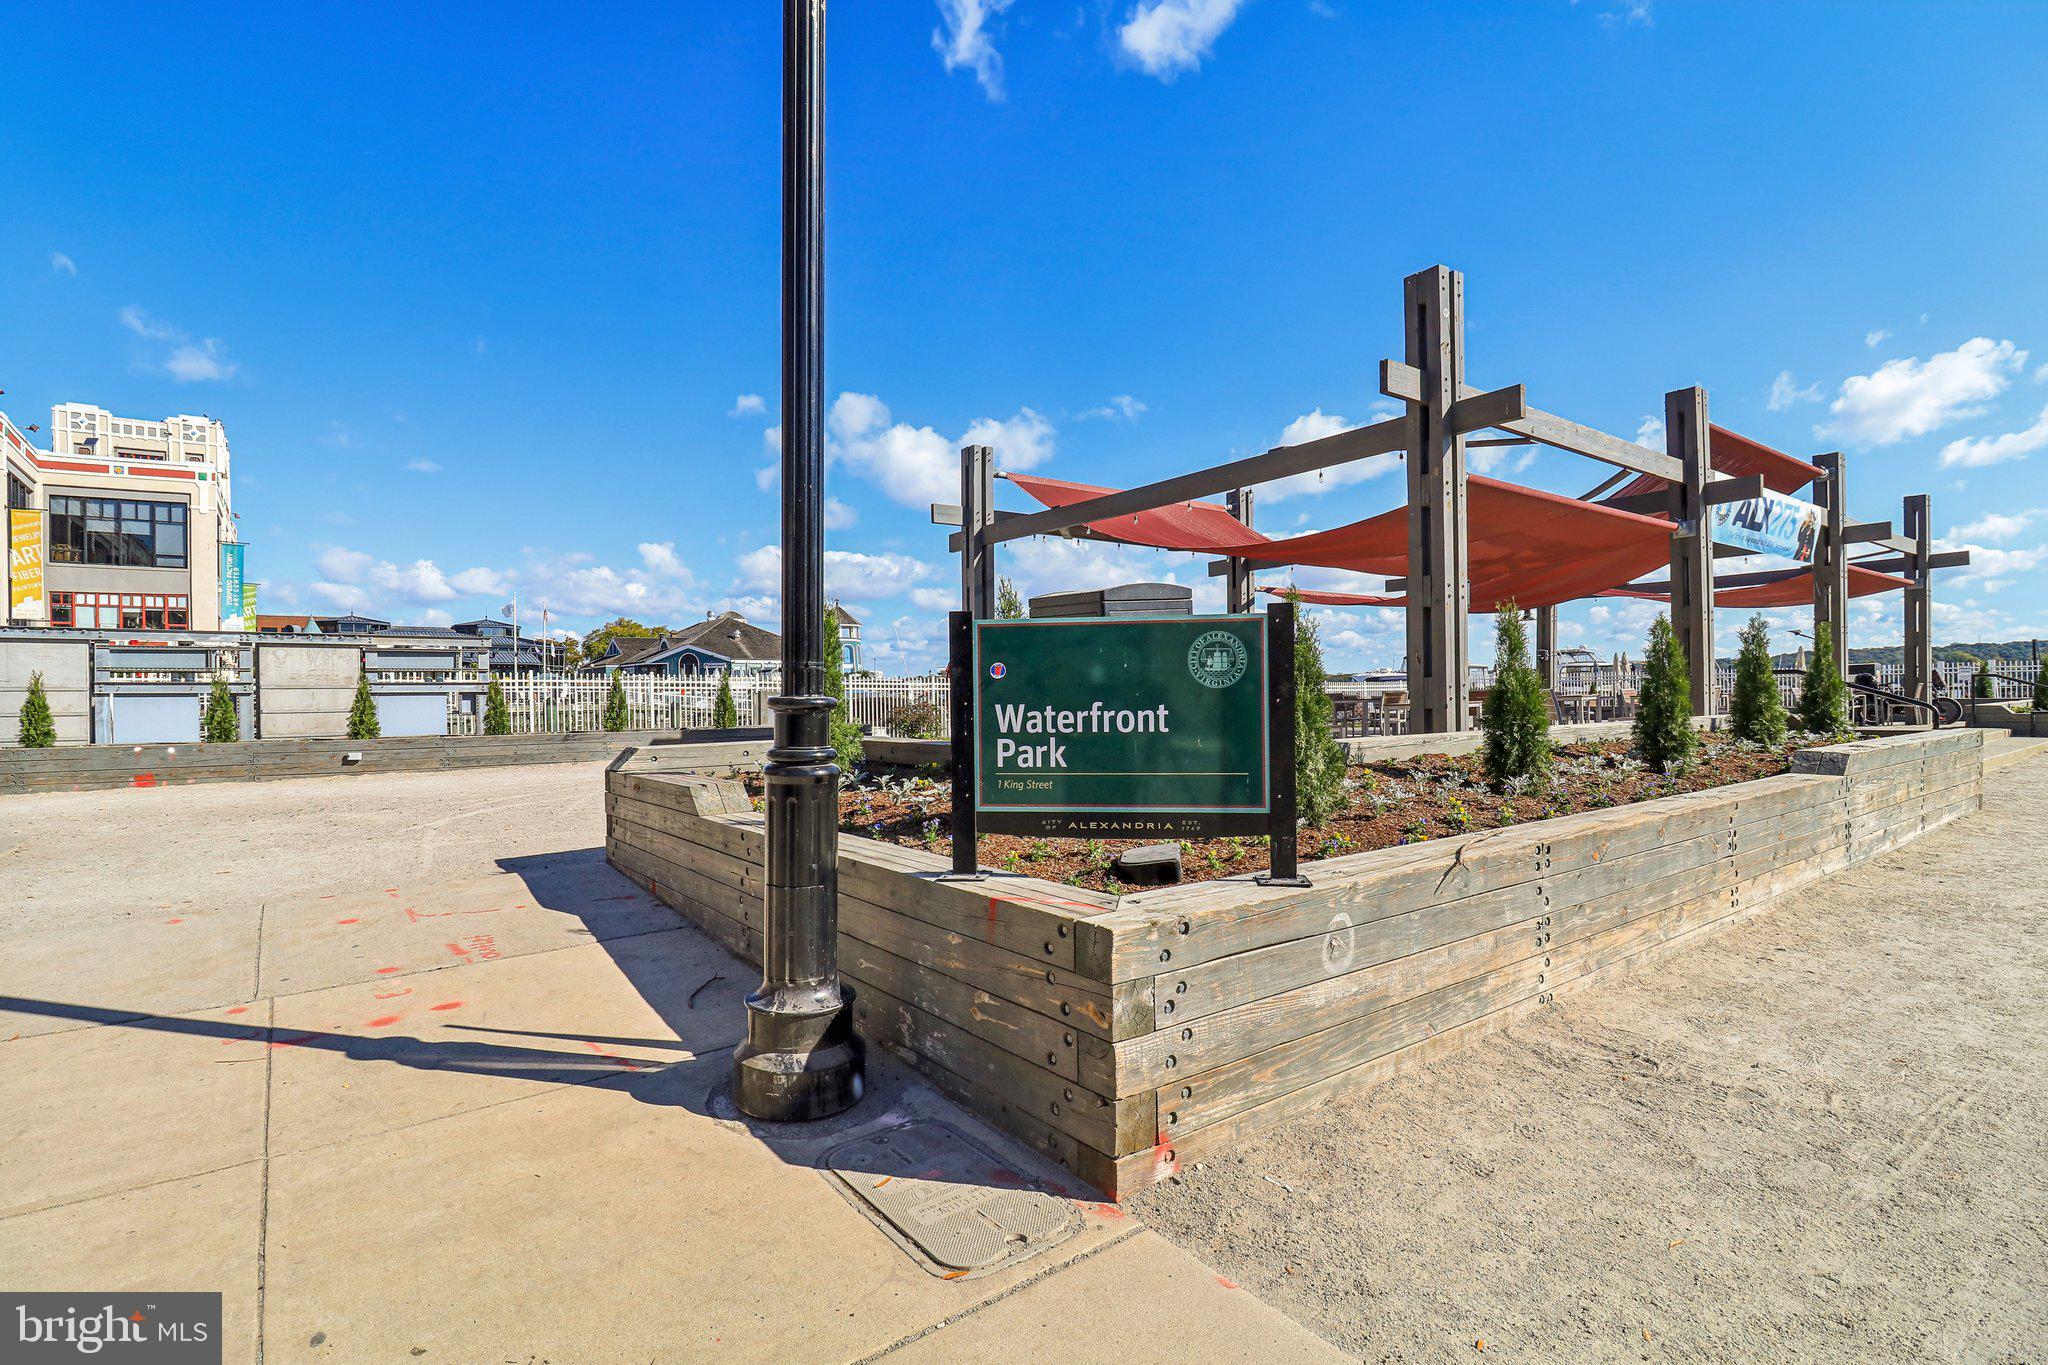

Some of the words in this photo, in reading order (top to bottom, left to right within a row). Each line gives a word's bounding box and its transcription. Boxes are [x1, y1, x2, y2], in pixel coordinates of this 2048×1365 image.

[12, 567, 41, 582] FIBER
[1190, 648, 1198, 670] CITY
[1195, 637, 1205, 649] OF
[1206, 632, 1245, 669] ALEXANDRIA
[1195, 671, 1240, 687] VIRGINIA
[995, 701, 1169, 733] Waterfront
[997, 737, 1067, 768] Park
[1004, 779, 1024, 791] King
[1026, 779, 1053, 789] Street
[1068, 822, 1173, 830] ALEXANDRIA
